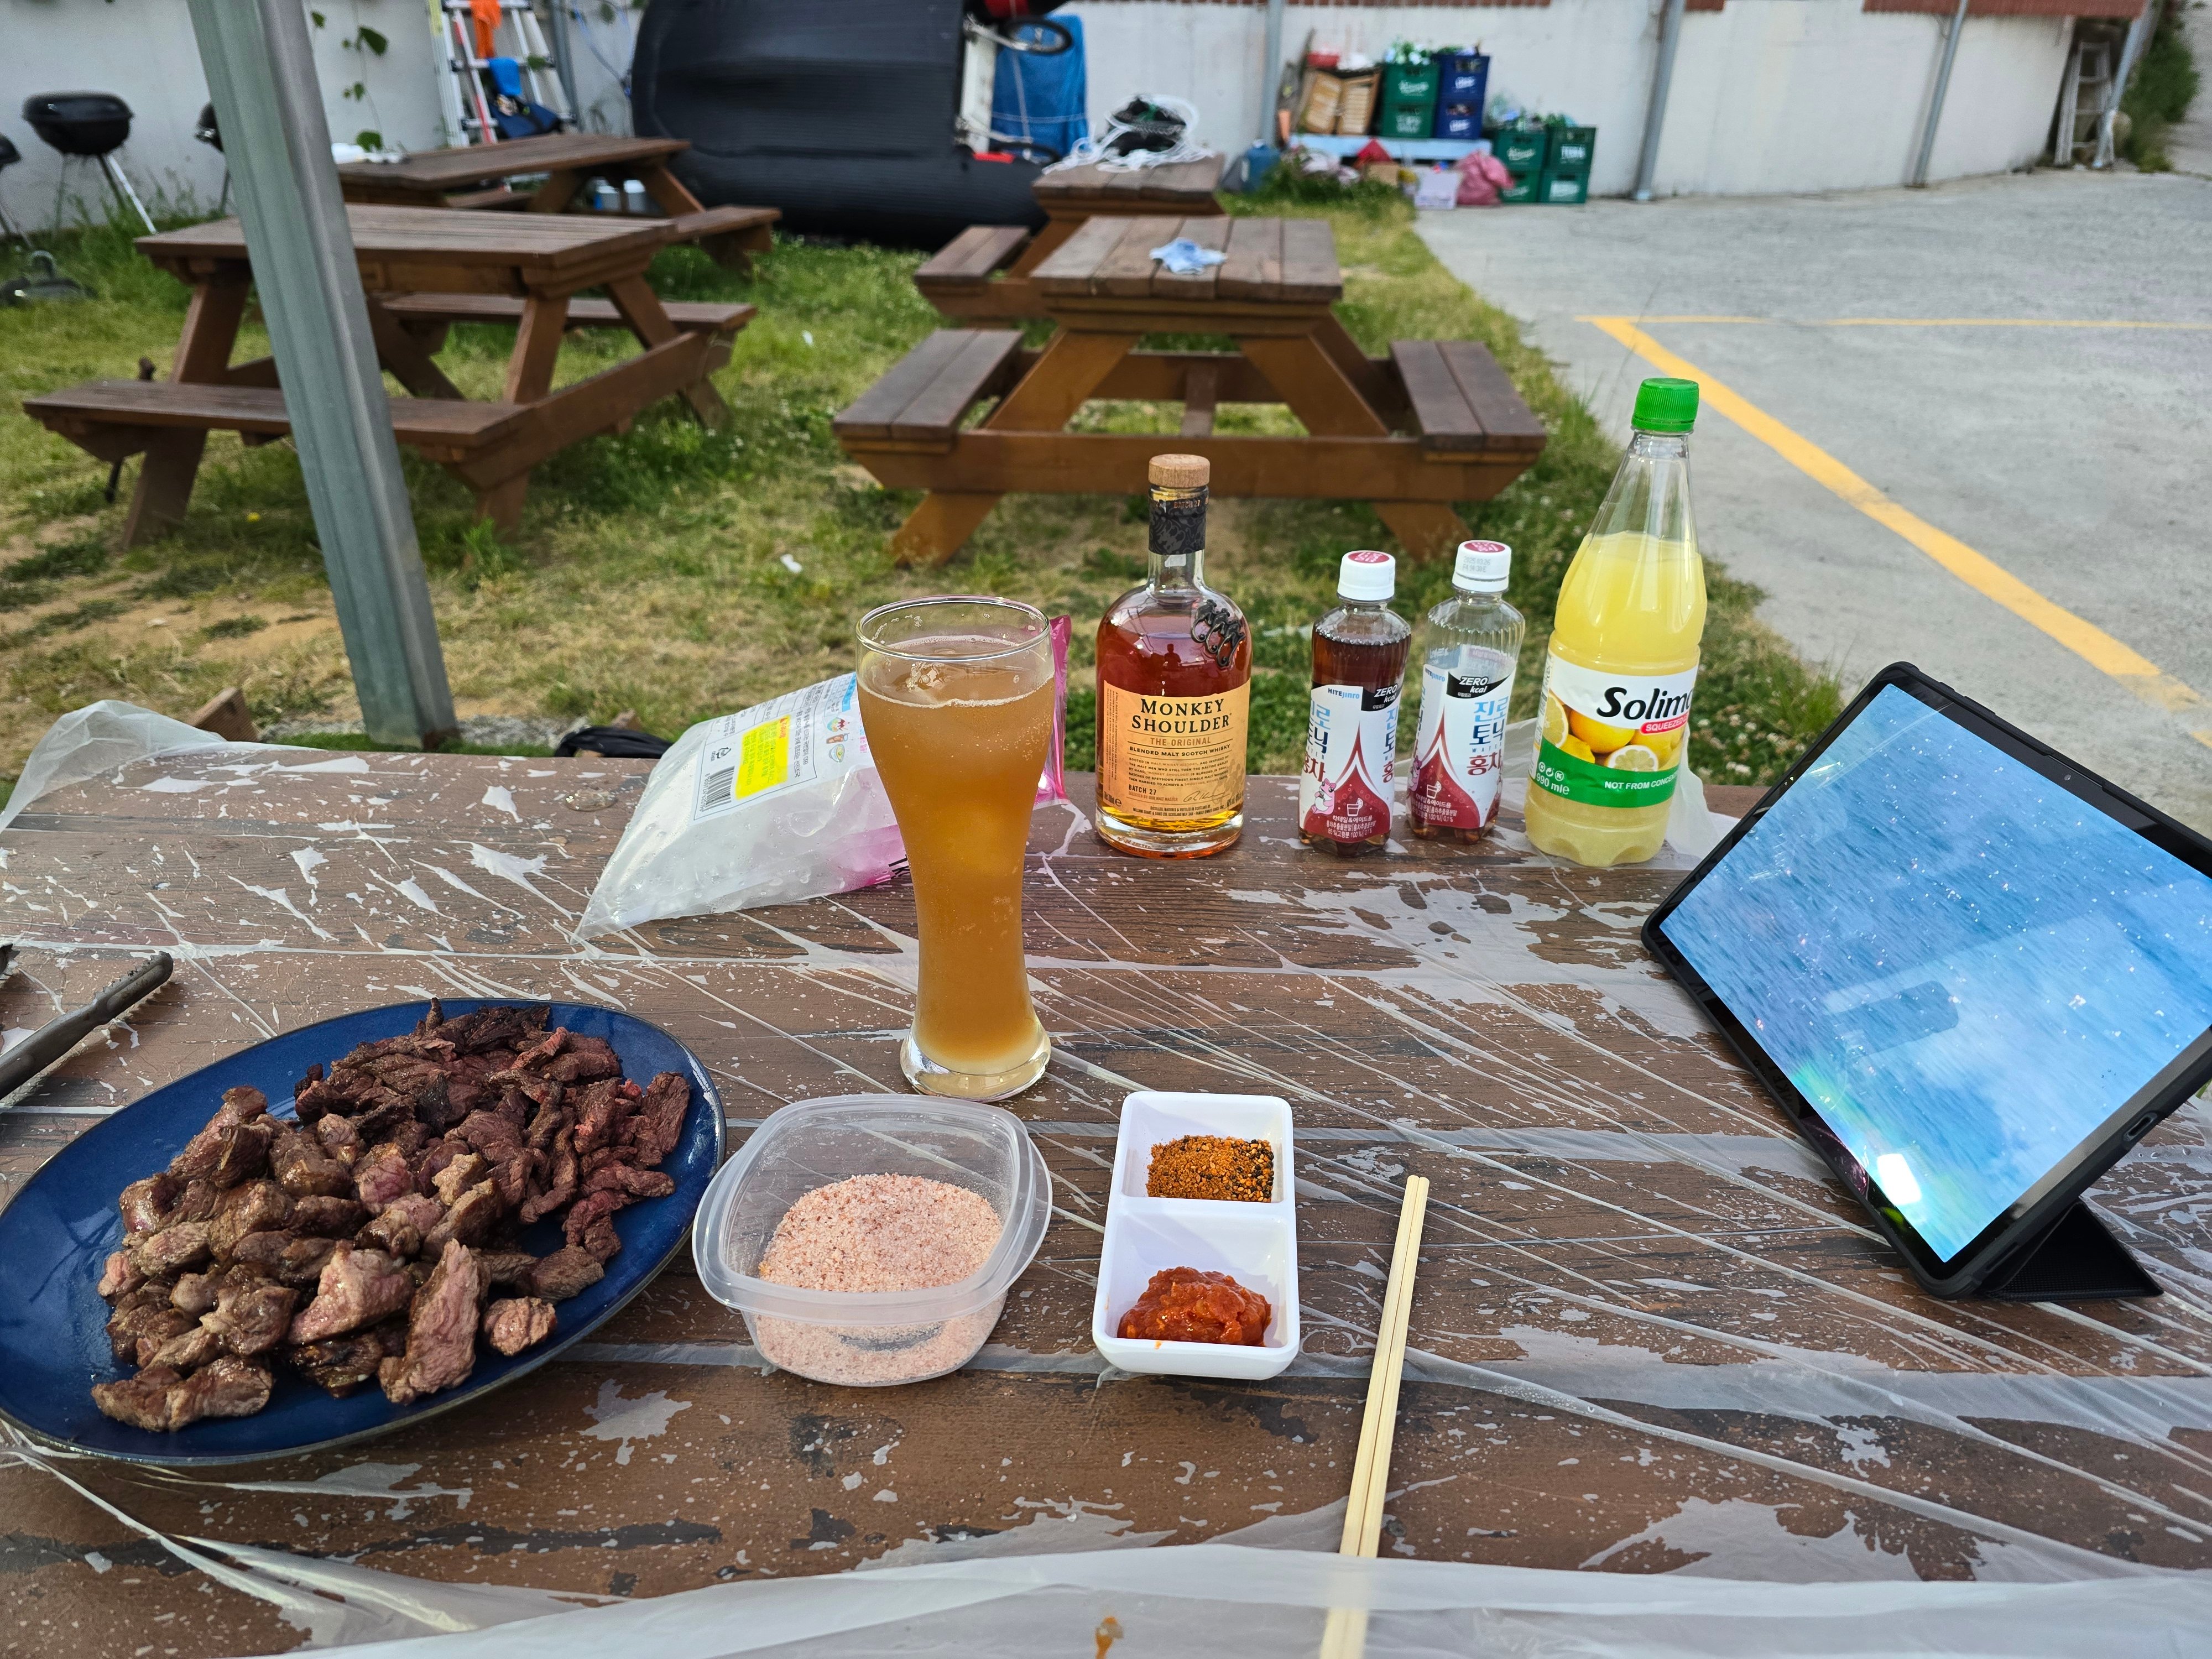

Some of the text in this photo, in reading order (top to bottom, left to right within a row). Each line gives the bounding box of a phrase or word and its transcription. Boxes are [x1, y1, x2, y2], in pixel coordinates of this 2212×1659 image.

[1459, 677, 1488, 686] ZERO
[1374, 684, 1397, 697] ZERO
[1384, 692, 1397, 703] kcal
[1141, 698, 1224, 716] MONKEY
[1473, 696, 1509, 722] 진로
[1132, 714, 1229, 733] SHOULDER
[1646, 717, 1683, 732] SQUEEZED
[1469, 719, 1505, 745] 토닉
[1171, 737, 1211, 746] ORIGINAL
[1130, 747, 1159, 755] BLENDED
[1209, 744, 1230, 753] WHISKY
[1467, 749, 1502, 775] 홍차
[1536, 773, 1549, 787] 990
[1604, 781, 1624, 789] NOT
[1625, 781, 1650, 790] FROM
[1129, 784, 1146, 794] BATCH
